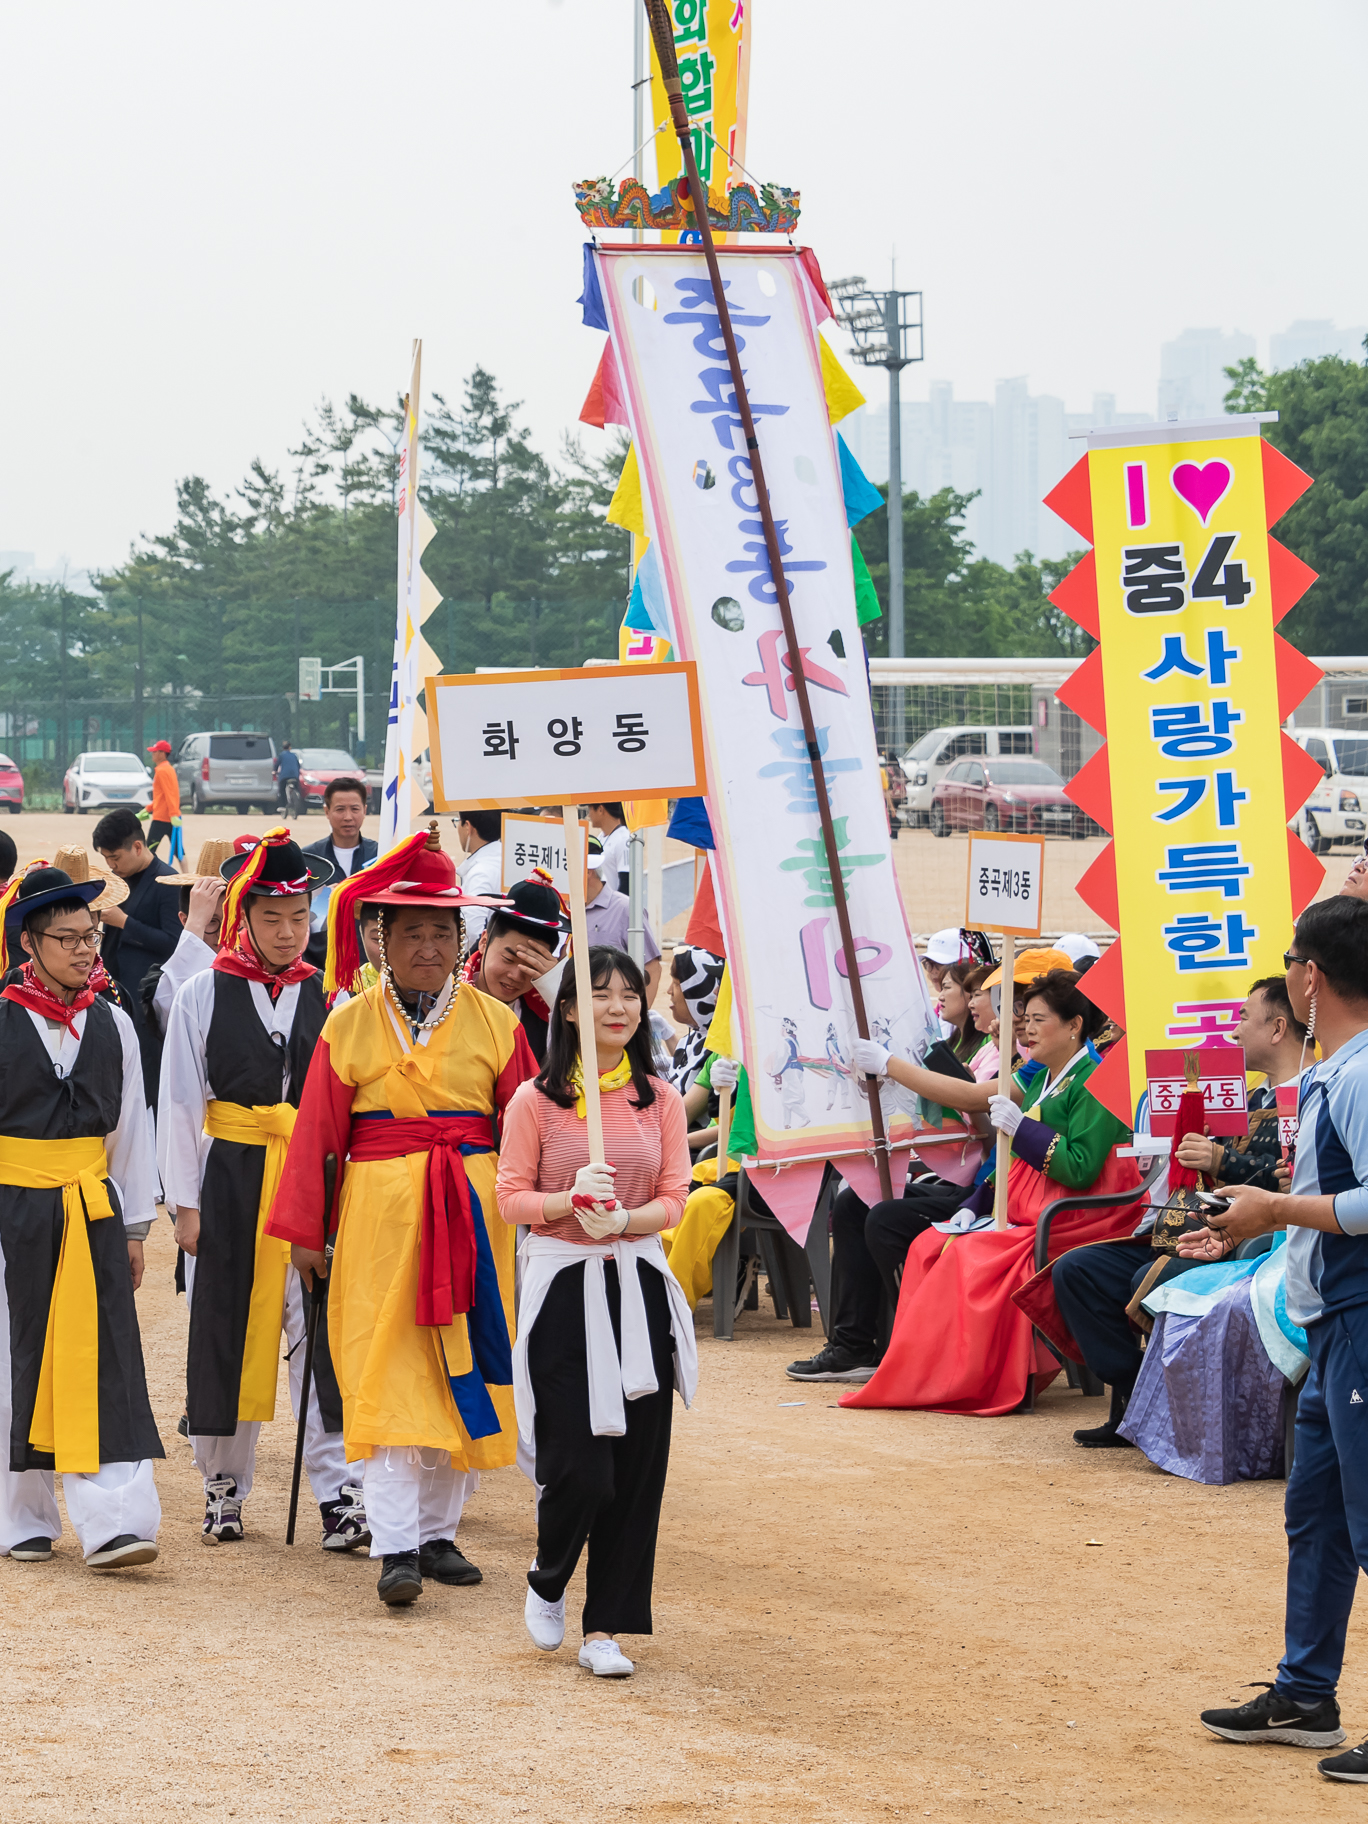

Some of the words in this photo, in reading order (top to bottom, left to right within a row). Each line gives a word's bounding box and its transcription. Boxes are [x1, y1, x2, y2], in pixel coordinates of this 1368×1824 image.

[1122, 536, 1252, 613] 중4
[979, 867, 1031, 900] 중곡제3동
[1155, 1082, 1239, 1109] 중4동
